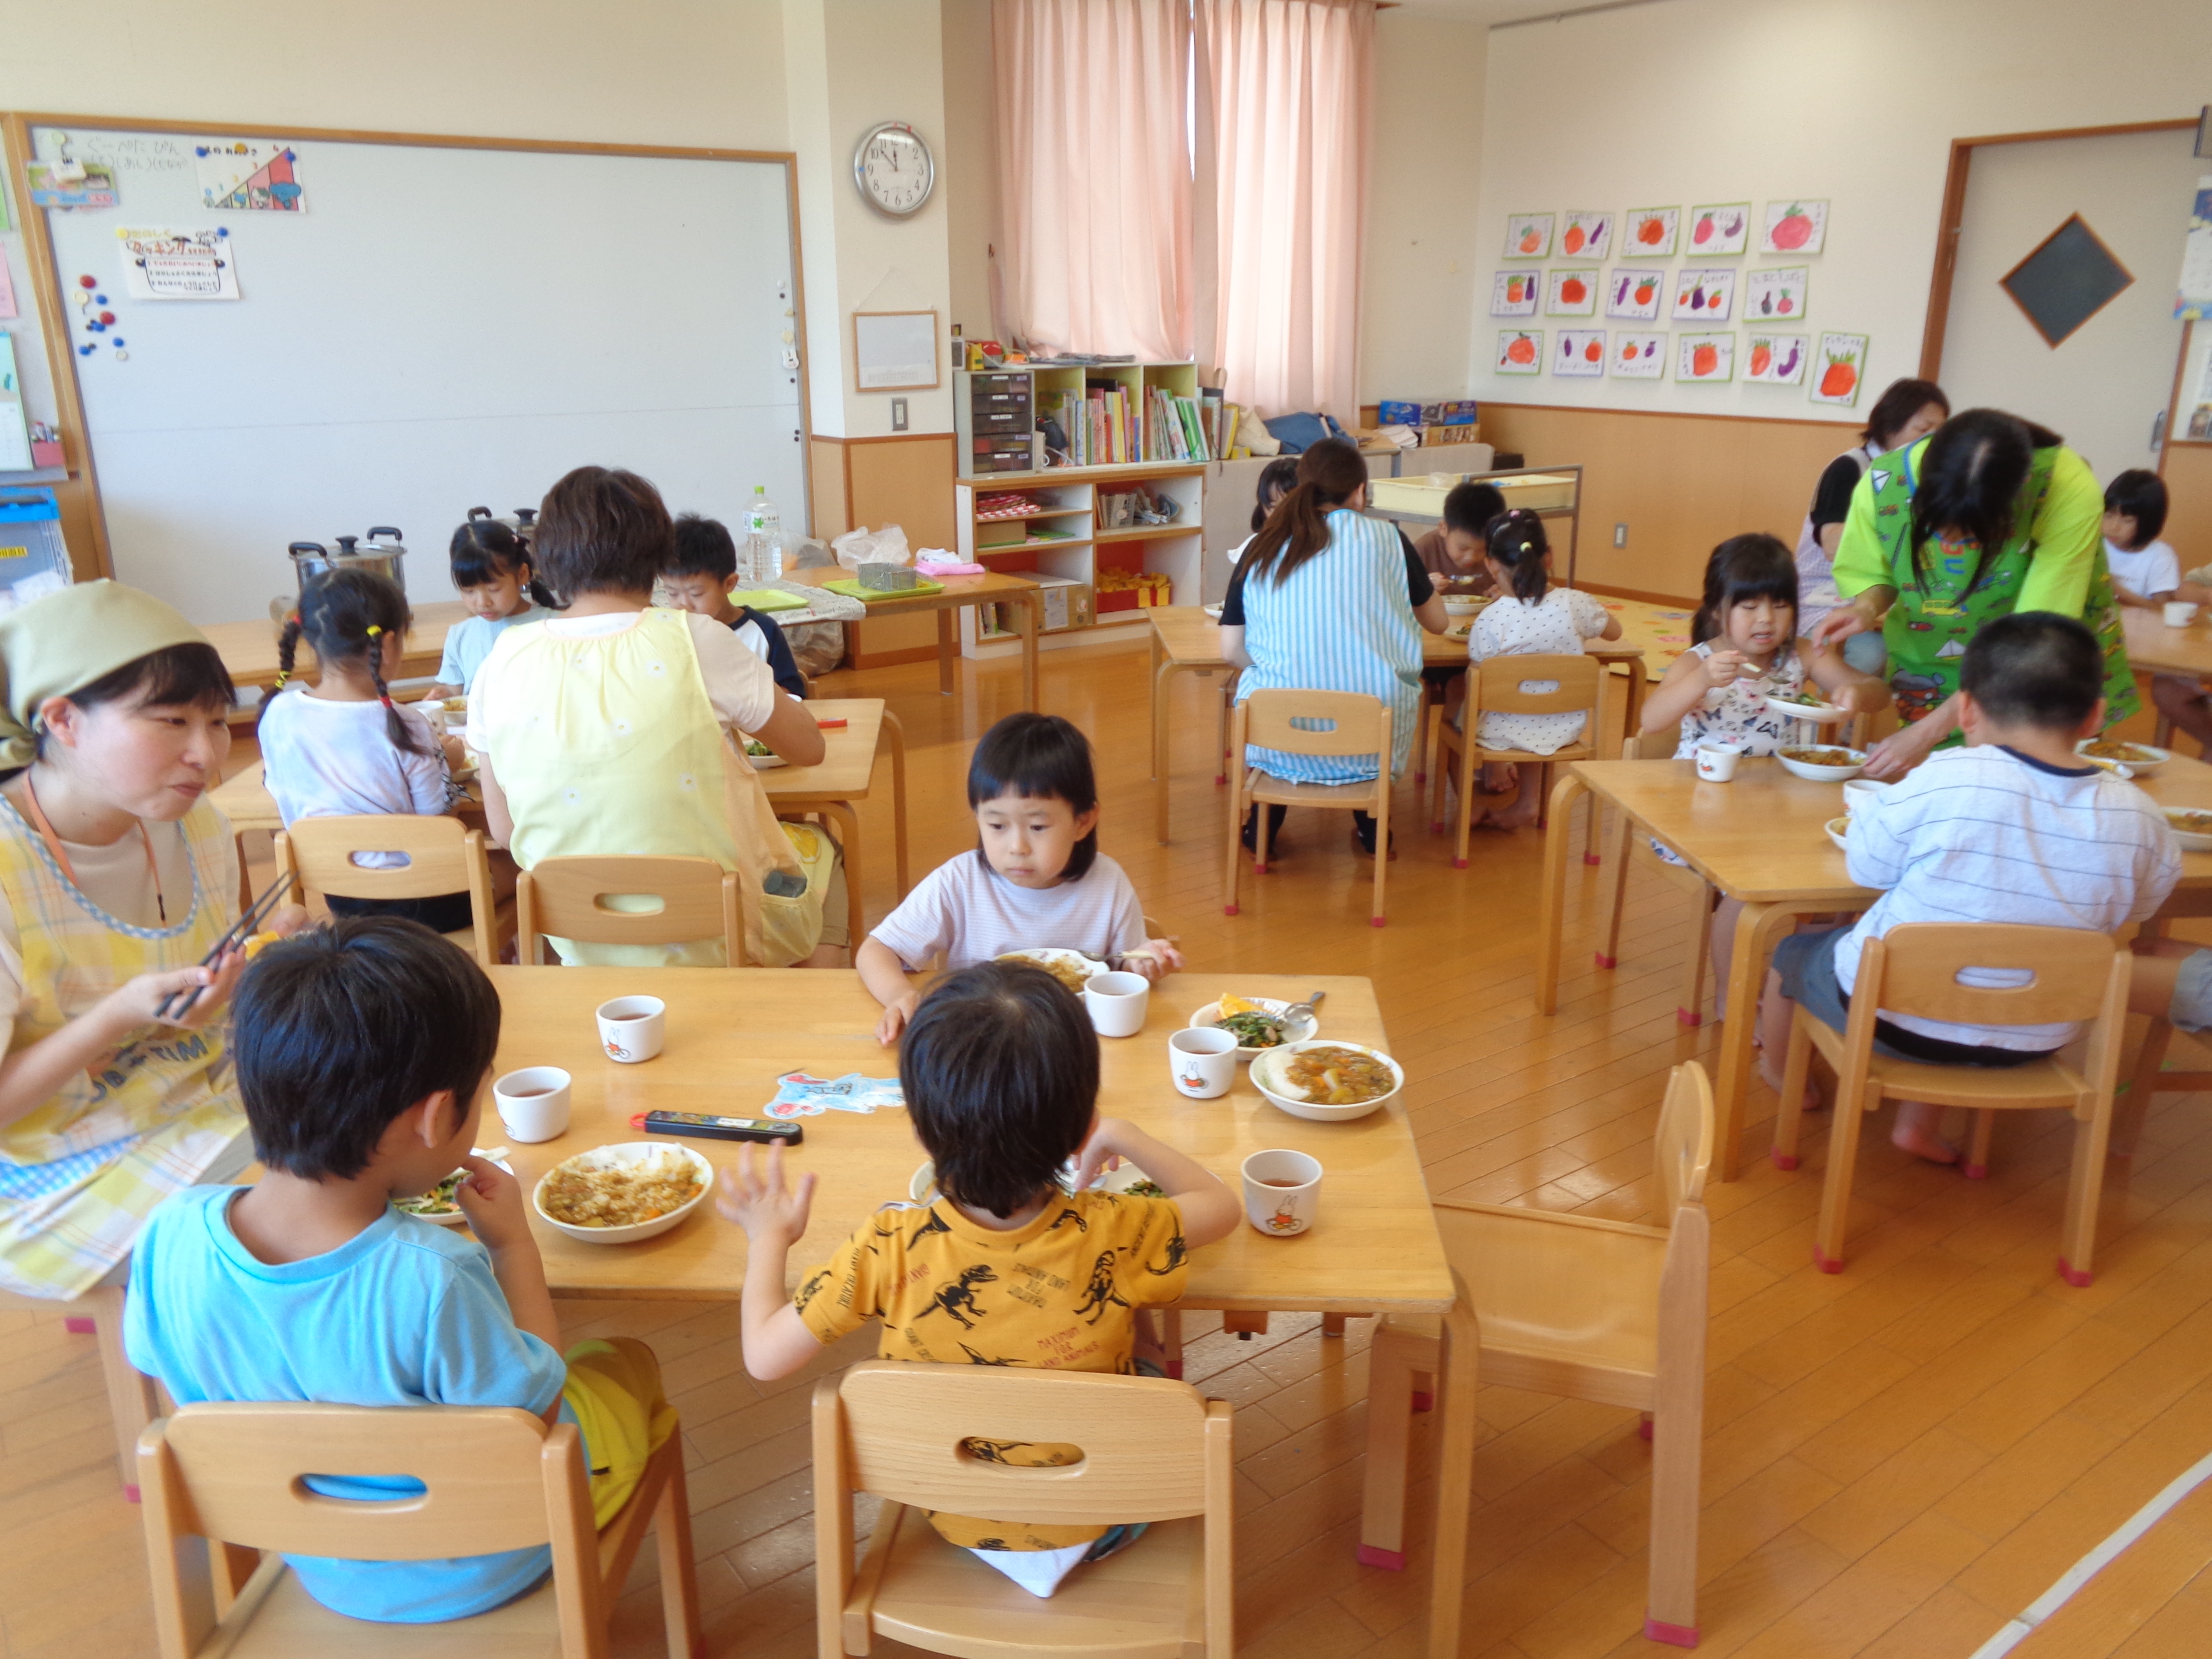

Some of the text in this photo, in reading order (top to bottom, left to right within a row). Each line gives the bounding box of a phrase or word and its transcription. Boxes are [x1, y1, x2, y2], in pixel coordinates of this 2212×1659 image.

[870, 147, 879, 159] 10
[913, 148, 919, 159] 2
[867, 164, 874, 176] 9
[917, 164, 924, 175] 3
[873, 179, 880, 191] 8
[914, 179, 920, 190] 4
[883, 190, 890, 202] 7
[895, 195, 901, 206] 6
[907, 190, 913, 202] 5
